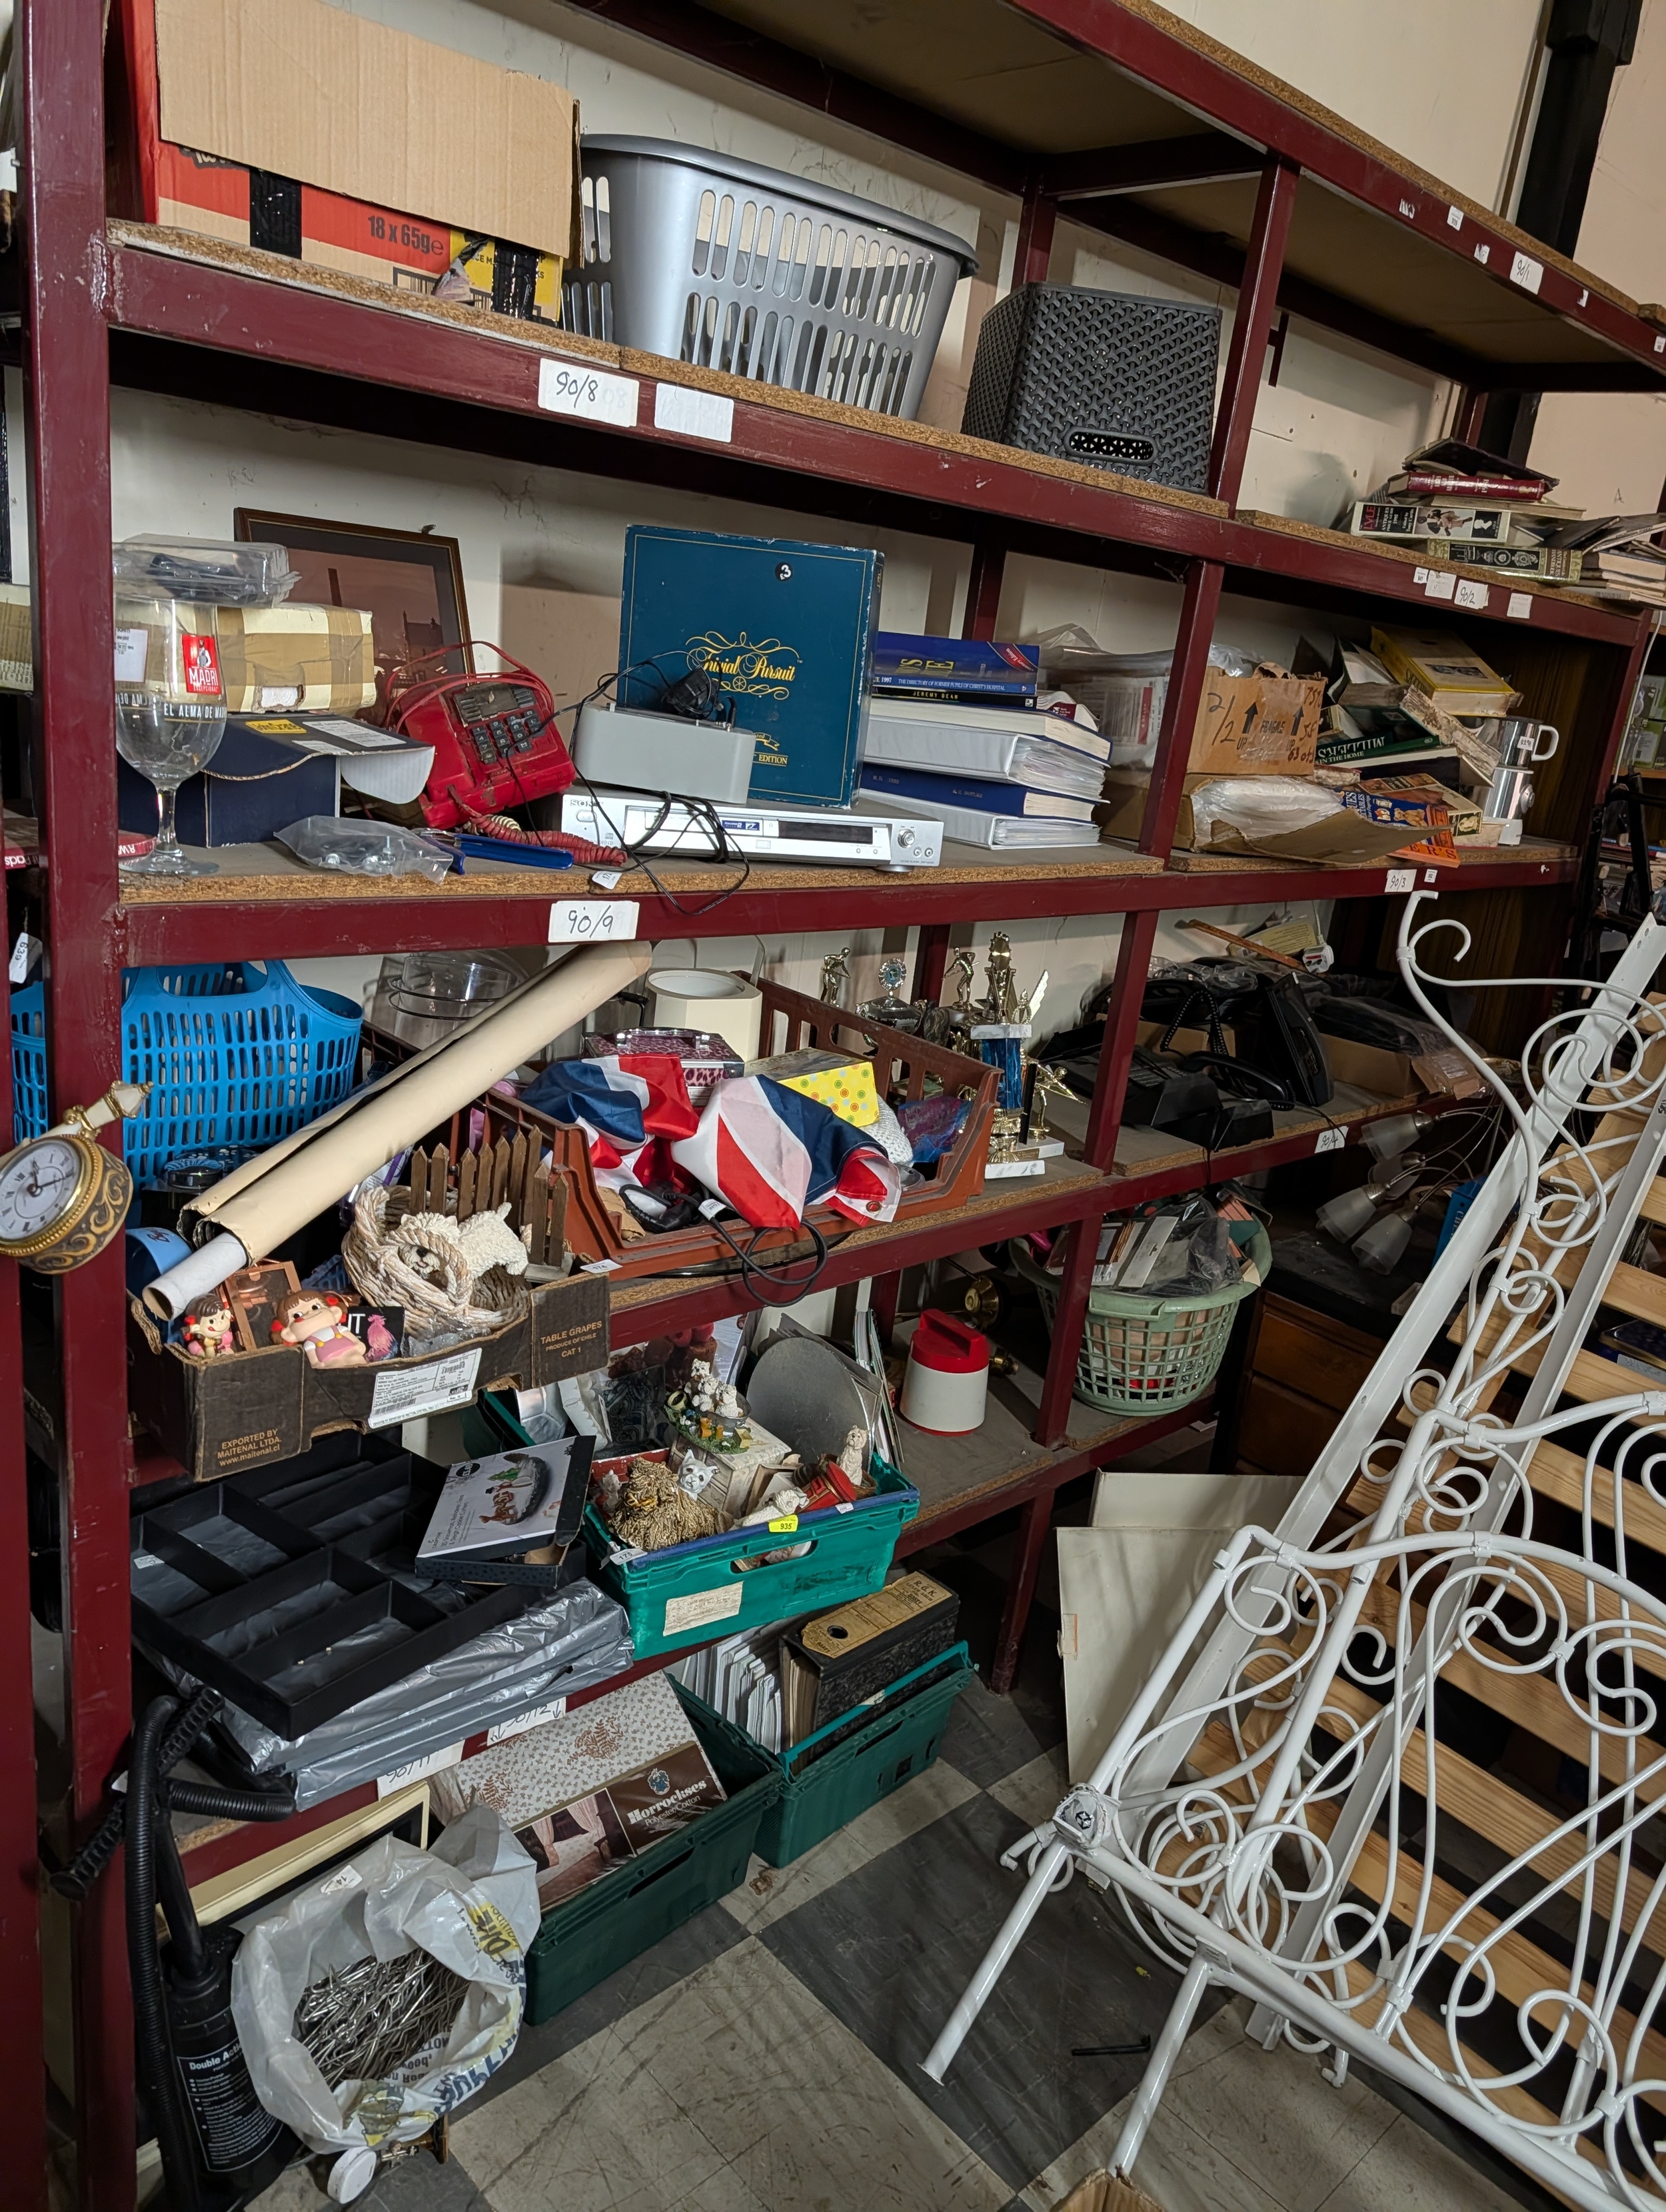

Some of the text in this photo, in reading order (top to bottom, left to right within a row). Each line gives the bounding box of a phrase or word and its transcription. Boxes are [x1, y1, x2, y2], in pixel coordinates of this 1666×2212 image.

[369, 215, 385, 240] 18
[389, 225, 397, 244] x
[556, 371, 598, 408] 90/8
[1363, 506, 1375, 530] LYLE
[1460, 586, 1475, 604] 90/2
[738, 652, 795, 682] Pursuit
[164, 704, 175, 716] EL
[179, 705, 201, 718] ALMA
[205, 706, 213, 718] DE
[1237, 737, 1248, 750] UP
[1286, 739, 1295, 752] UP
[758, 754, 788, 765] EDITION
[1343, 751, 1364, 760] HOME
[1390, 875, 1405, 891] 90/3
[568, 905, 613, 938] 90/9
[540, 1321, 602, 1344] TABLE GRAPES
[546, 1340, 572, 1351] PRODUCE
[581, 1333, 596, 1341] CHILE
[562, 1349, 576, 1357] CAT
[217, 1436, 282, 1458] MAITENAL LTDA.
[222, 1428, 278, 1449] EXPORTED BY
[219, 1444, 280, 1466] www.maitenal.cl
[626, 1780, 707, 1825] Horrockses
[644, 1795, 701, 1826] Polyester/Cotton
[189, 2057, 221, 2070] Double
